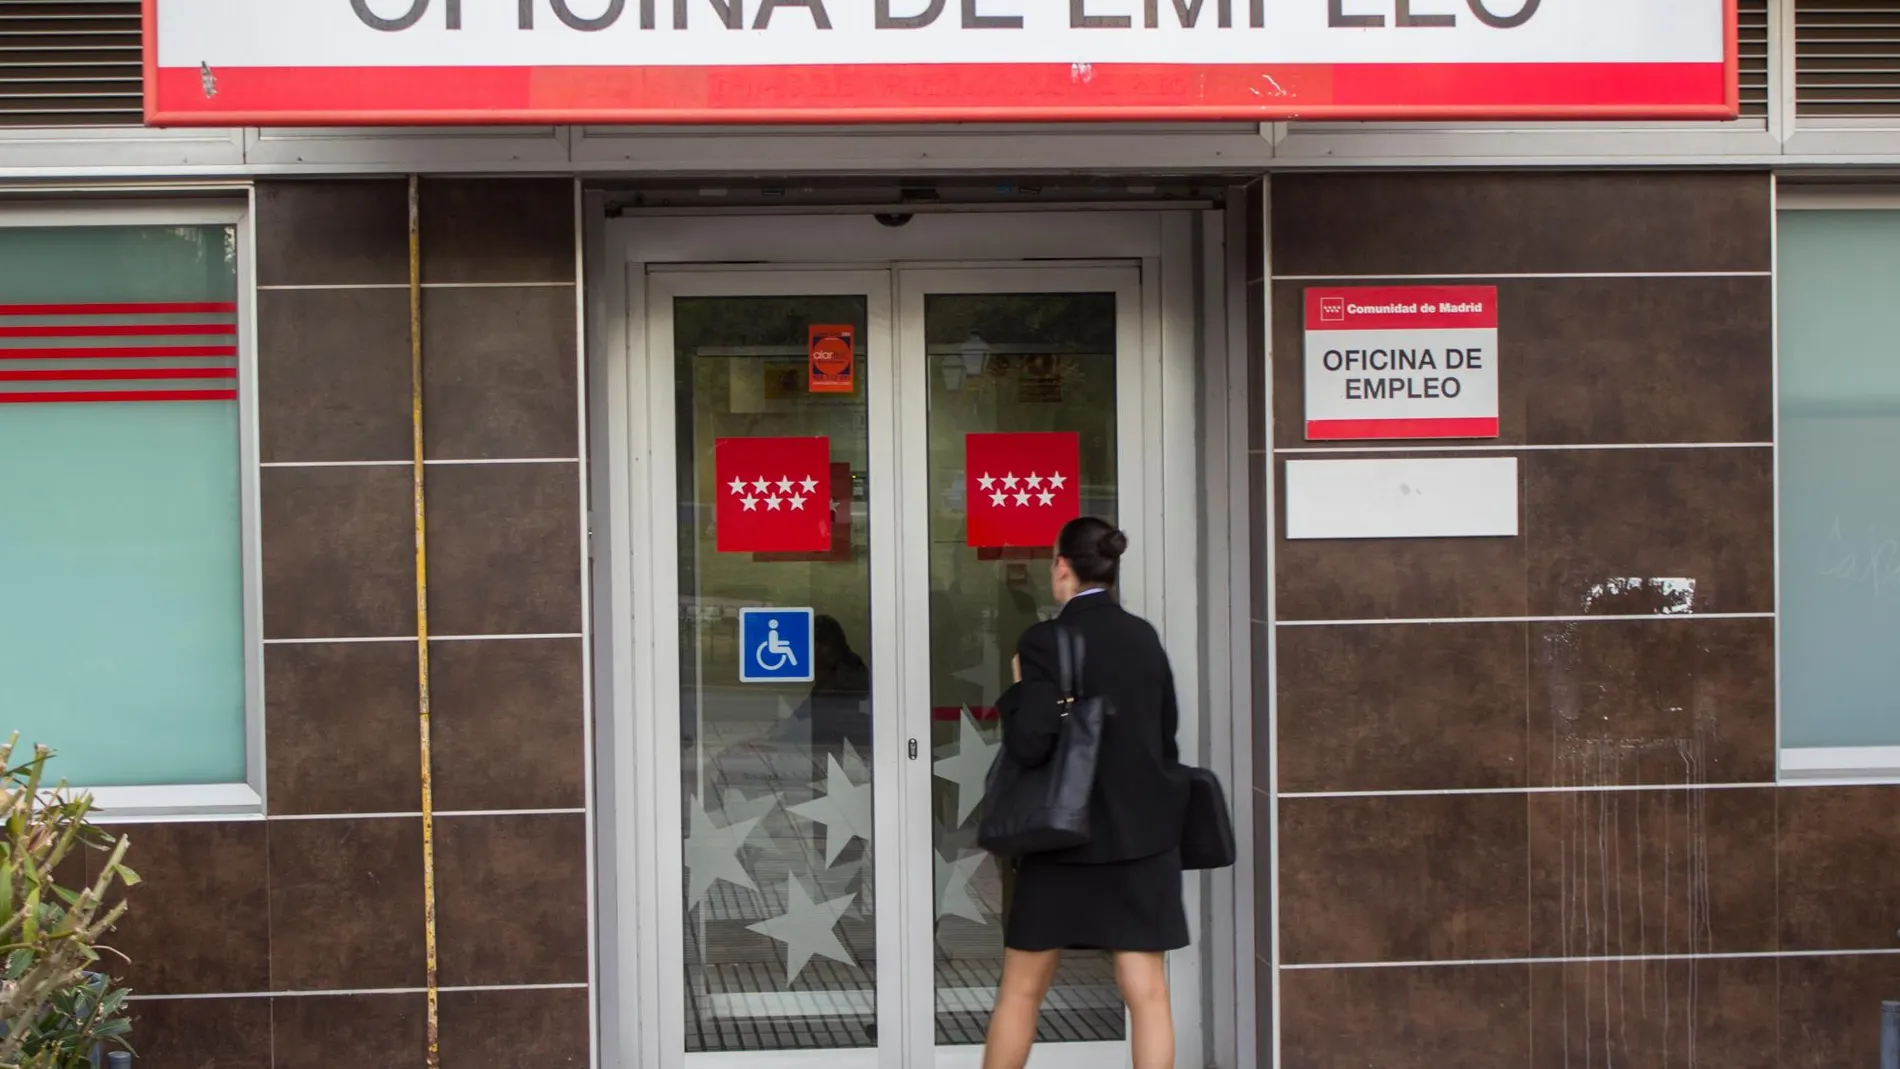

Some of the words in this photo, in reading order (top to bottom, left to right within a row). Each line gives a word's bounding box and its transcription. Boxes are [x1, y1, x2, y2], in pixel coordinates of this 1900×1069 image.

[1346, 303, 1417, 314] Comunidad
[1420, 303, 1436, 314] de
[1438, 302, 1483, 313] Madrid
[1323, 348, 1437, 372] OFICINA
[1446, 347, 1483, 371] DE
[1345, 376, 1461, 400] EMPLEO
